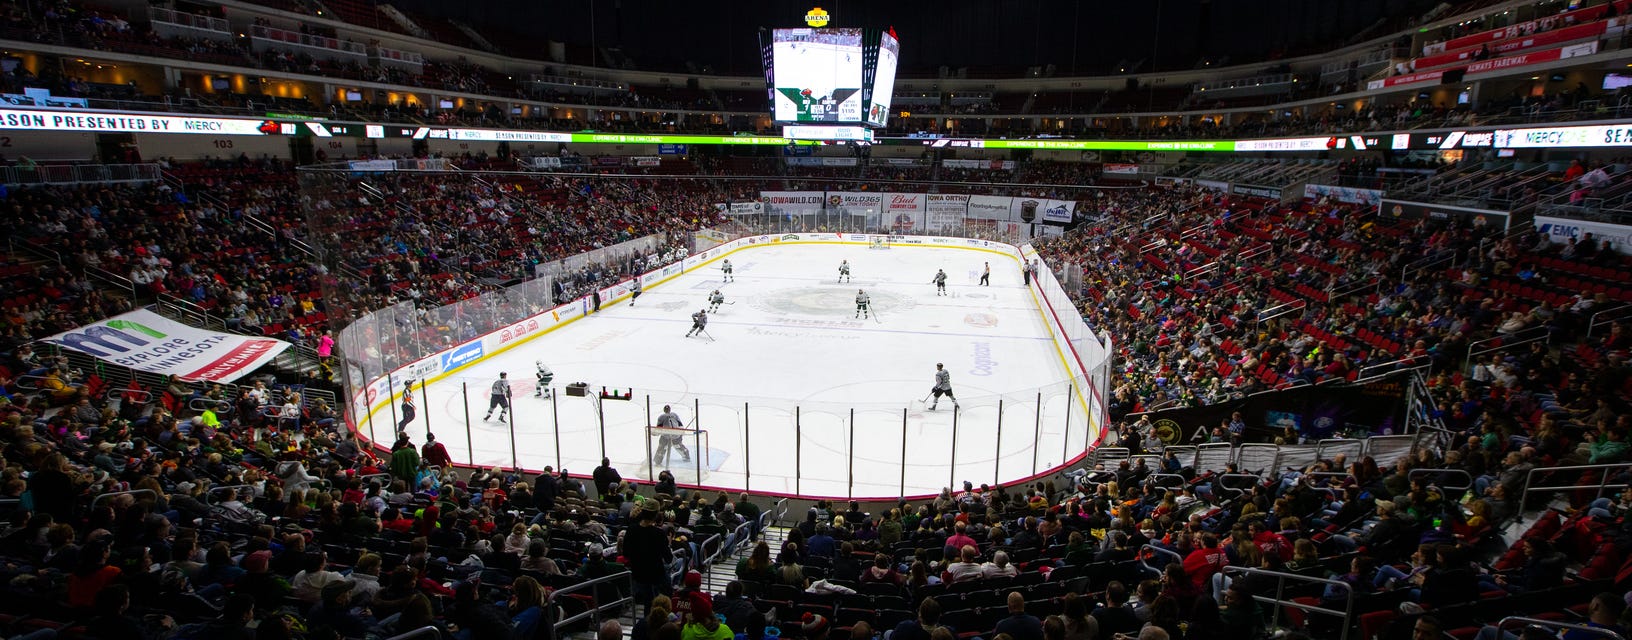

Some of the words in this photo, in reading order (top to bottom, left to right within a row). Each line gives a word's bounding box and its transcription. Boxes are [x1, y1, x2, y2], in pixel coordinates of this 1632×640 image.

[1467, 61, 1493, 72] ALWAYS
[53, 115, 146, 130] PRESENTED
[152, 119, 169, 130] BY
[213, 140, 233, 149] 103
[329, 141, 343, 149] 104
[770, 196, 823, 204] IOWAWILD.COM
[891, 194, 918, 204] Bud
[1552, 224, 1580, 237] EMC
